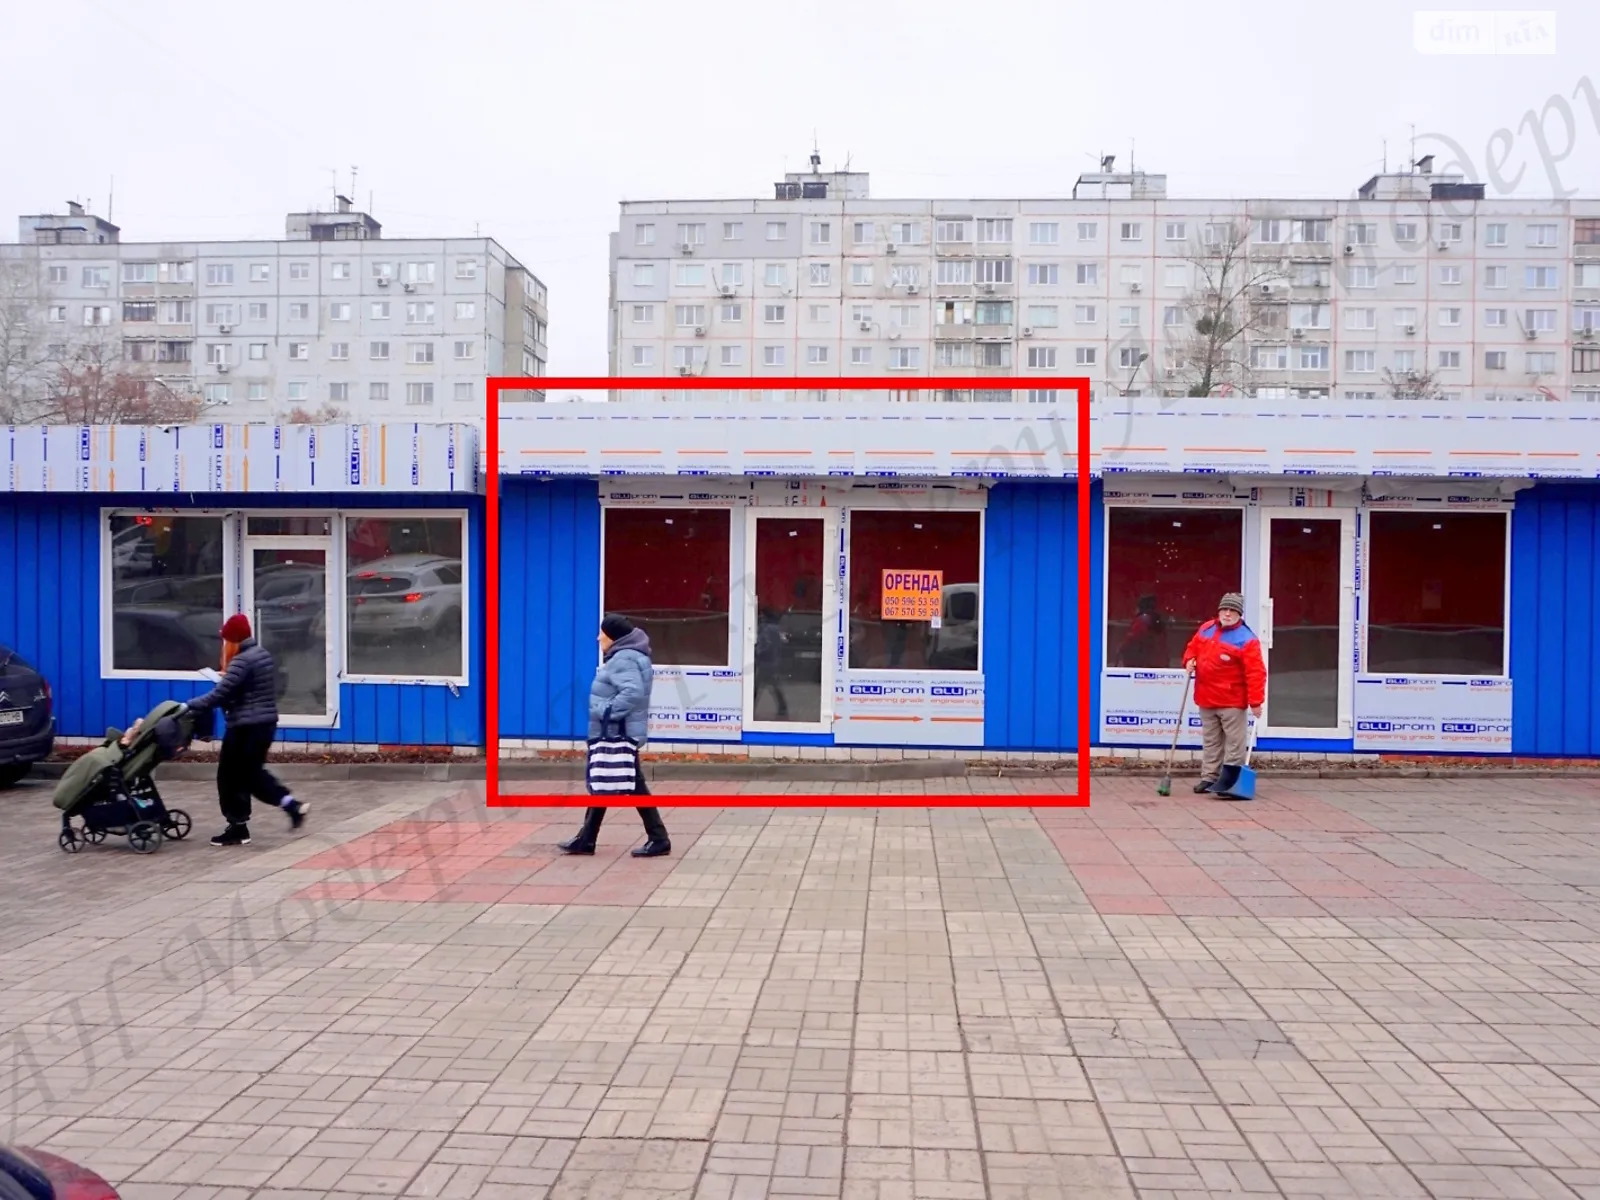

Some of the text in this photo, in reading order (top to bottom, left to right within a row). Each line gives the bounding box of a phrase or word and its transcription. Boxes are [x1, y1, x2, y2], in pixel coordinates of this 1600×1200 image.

[885, 573, 940, 594] ОРЕНДА
[885, 596, 900, 606] 050
[918, 597, 928, 606] 53
